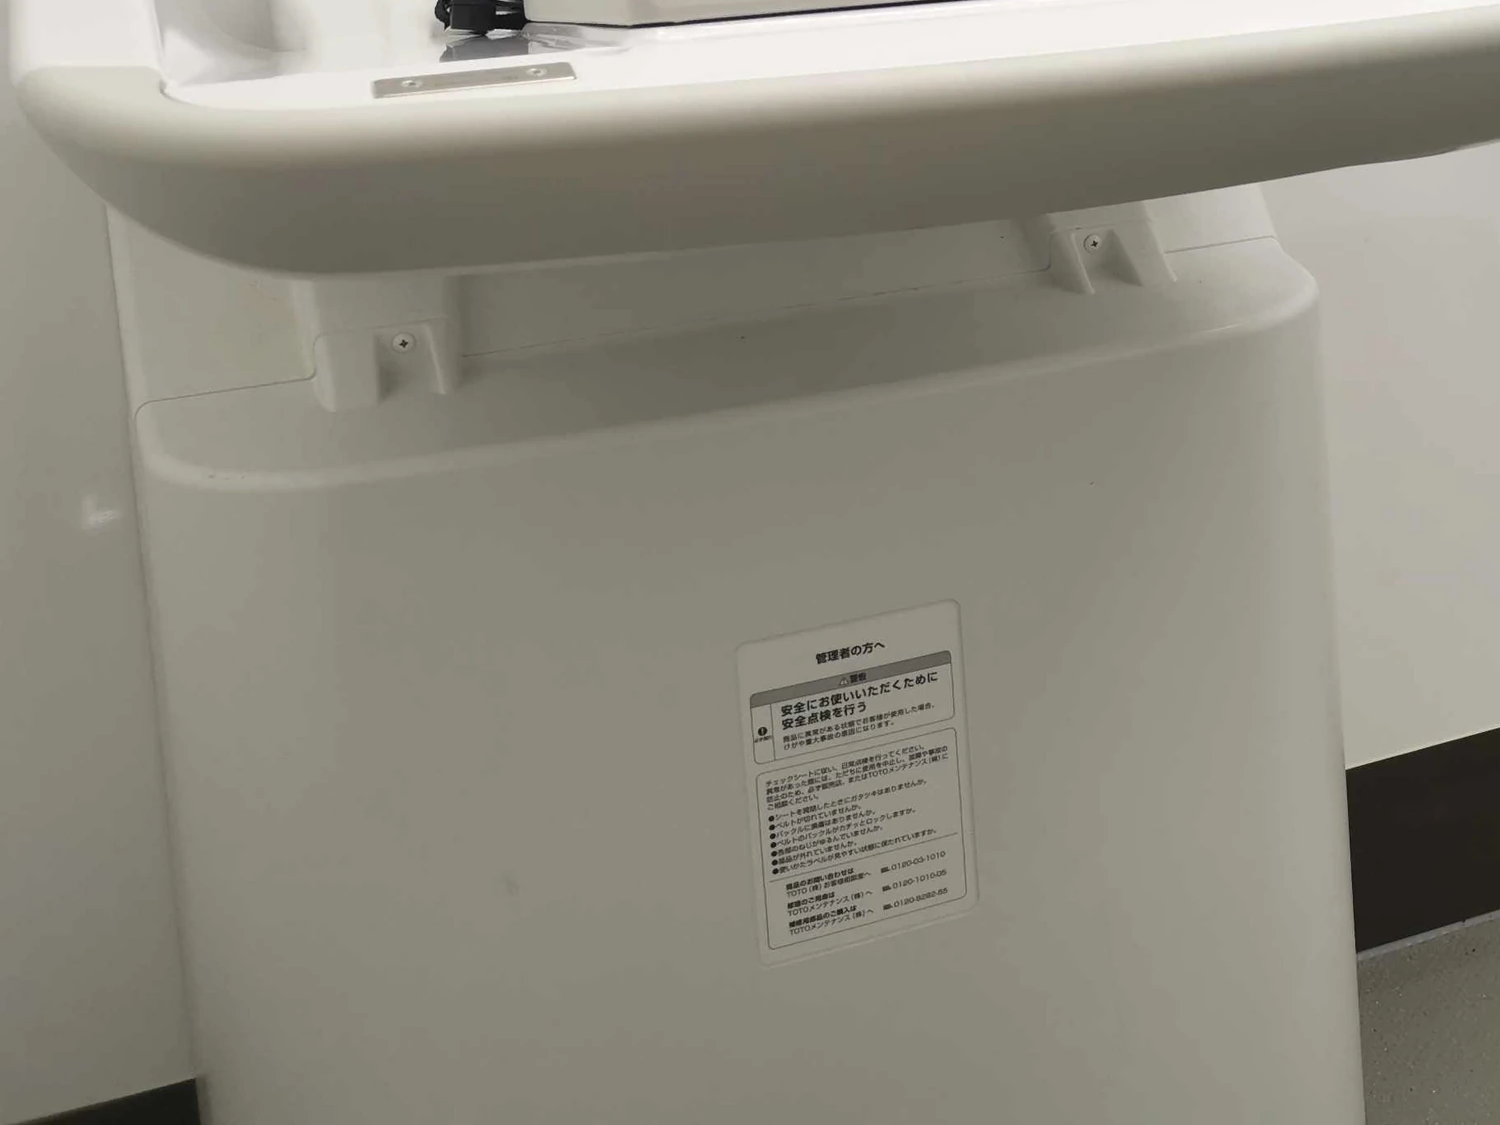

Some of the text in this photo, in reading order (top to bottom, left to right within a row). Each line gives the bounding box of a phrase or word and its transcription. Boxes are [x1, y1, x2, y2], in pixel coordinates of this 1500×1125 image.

[816, 641, 885, 664] 管理者の方へ
[781, 672, 938, 717] 安全にお使いいただくために
[782, 702, 866, 730] 安全点検を行う
